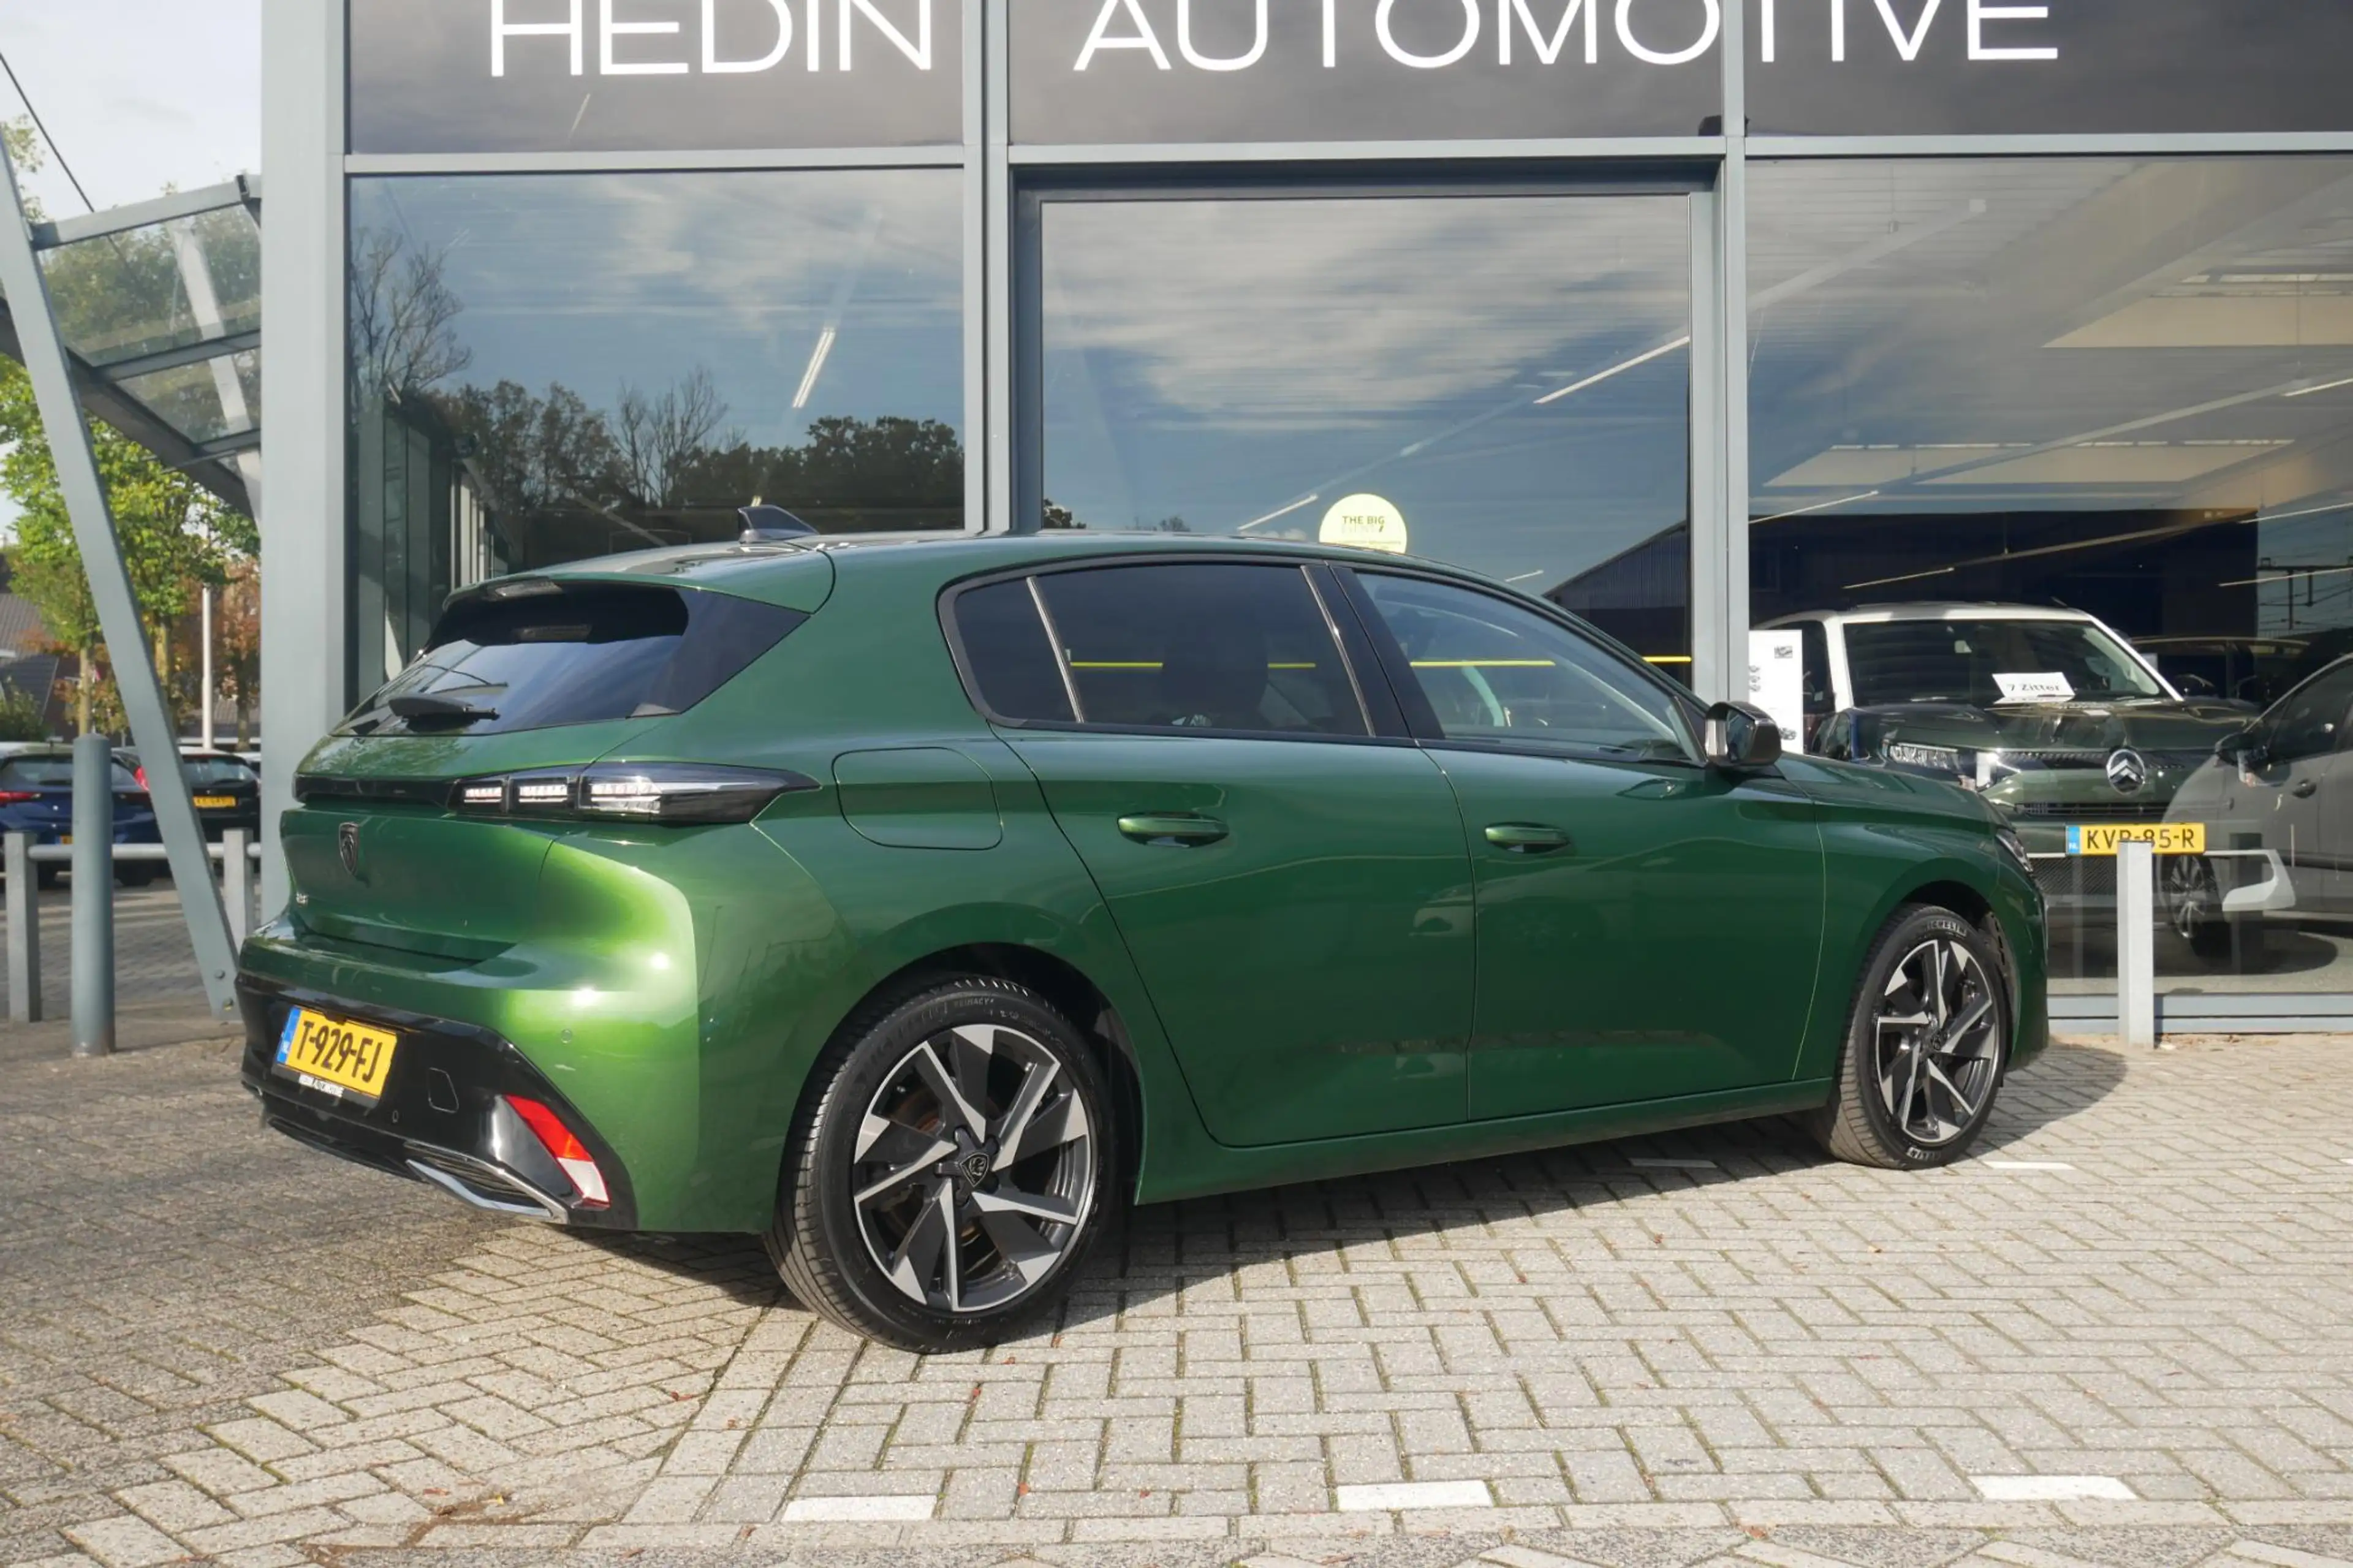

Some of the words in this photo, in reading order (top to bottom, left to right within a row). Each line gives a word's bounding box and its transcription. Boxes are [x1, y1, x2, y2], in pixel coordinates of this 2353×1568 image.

[491, 0, 931, 77] HEDIN
[1074, 0, 2057, 71] AUTOMOTIVE
[1367, 516, 1385, 525] BIG
[297, 1020, 384, 1083] T-929-FJ
